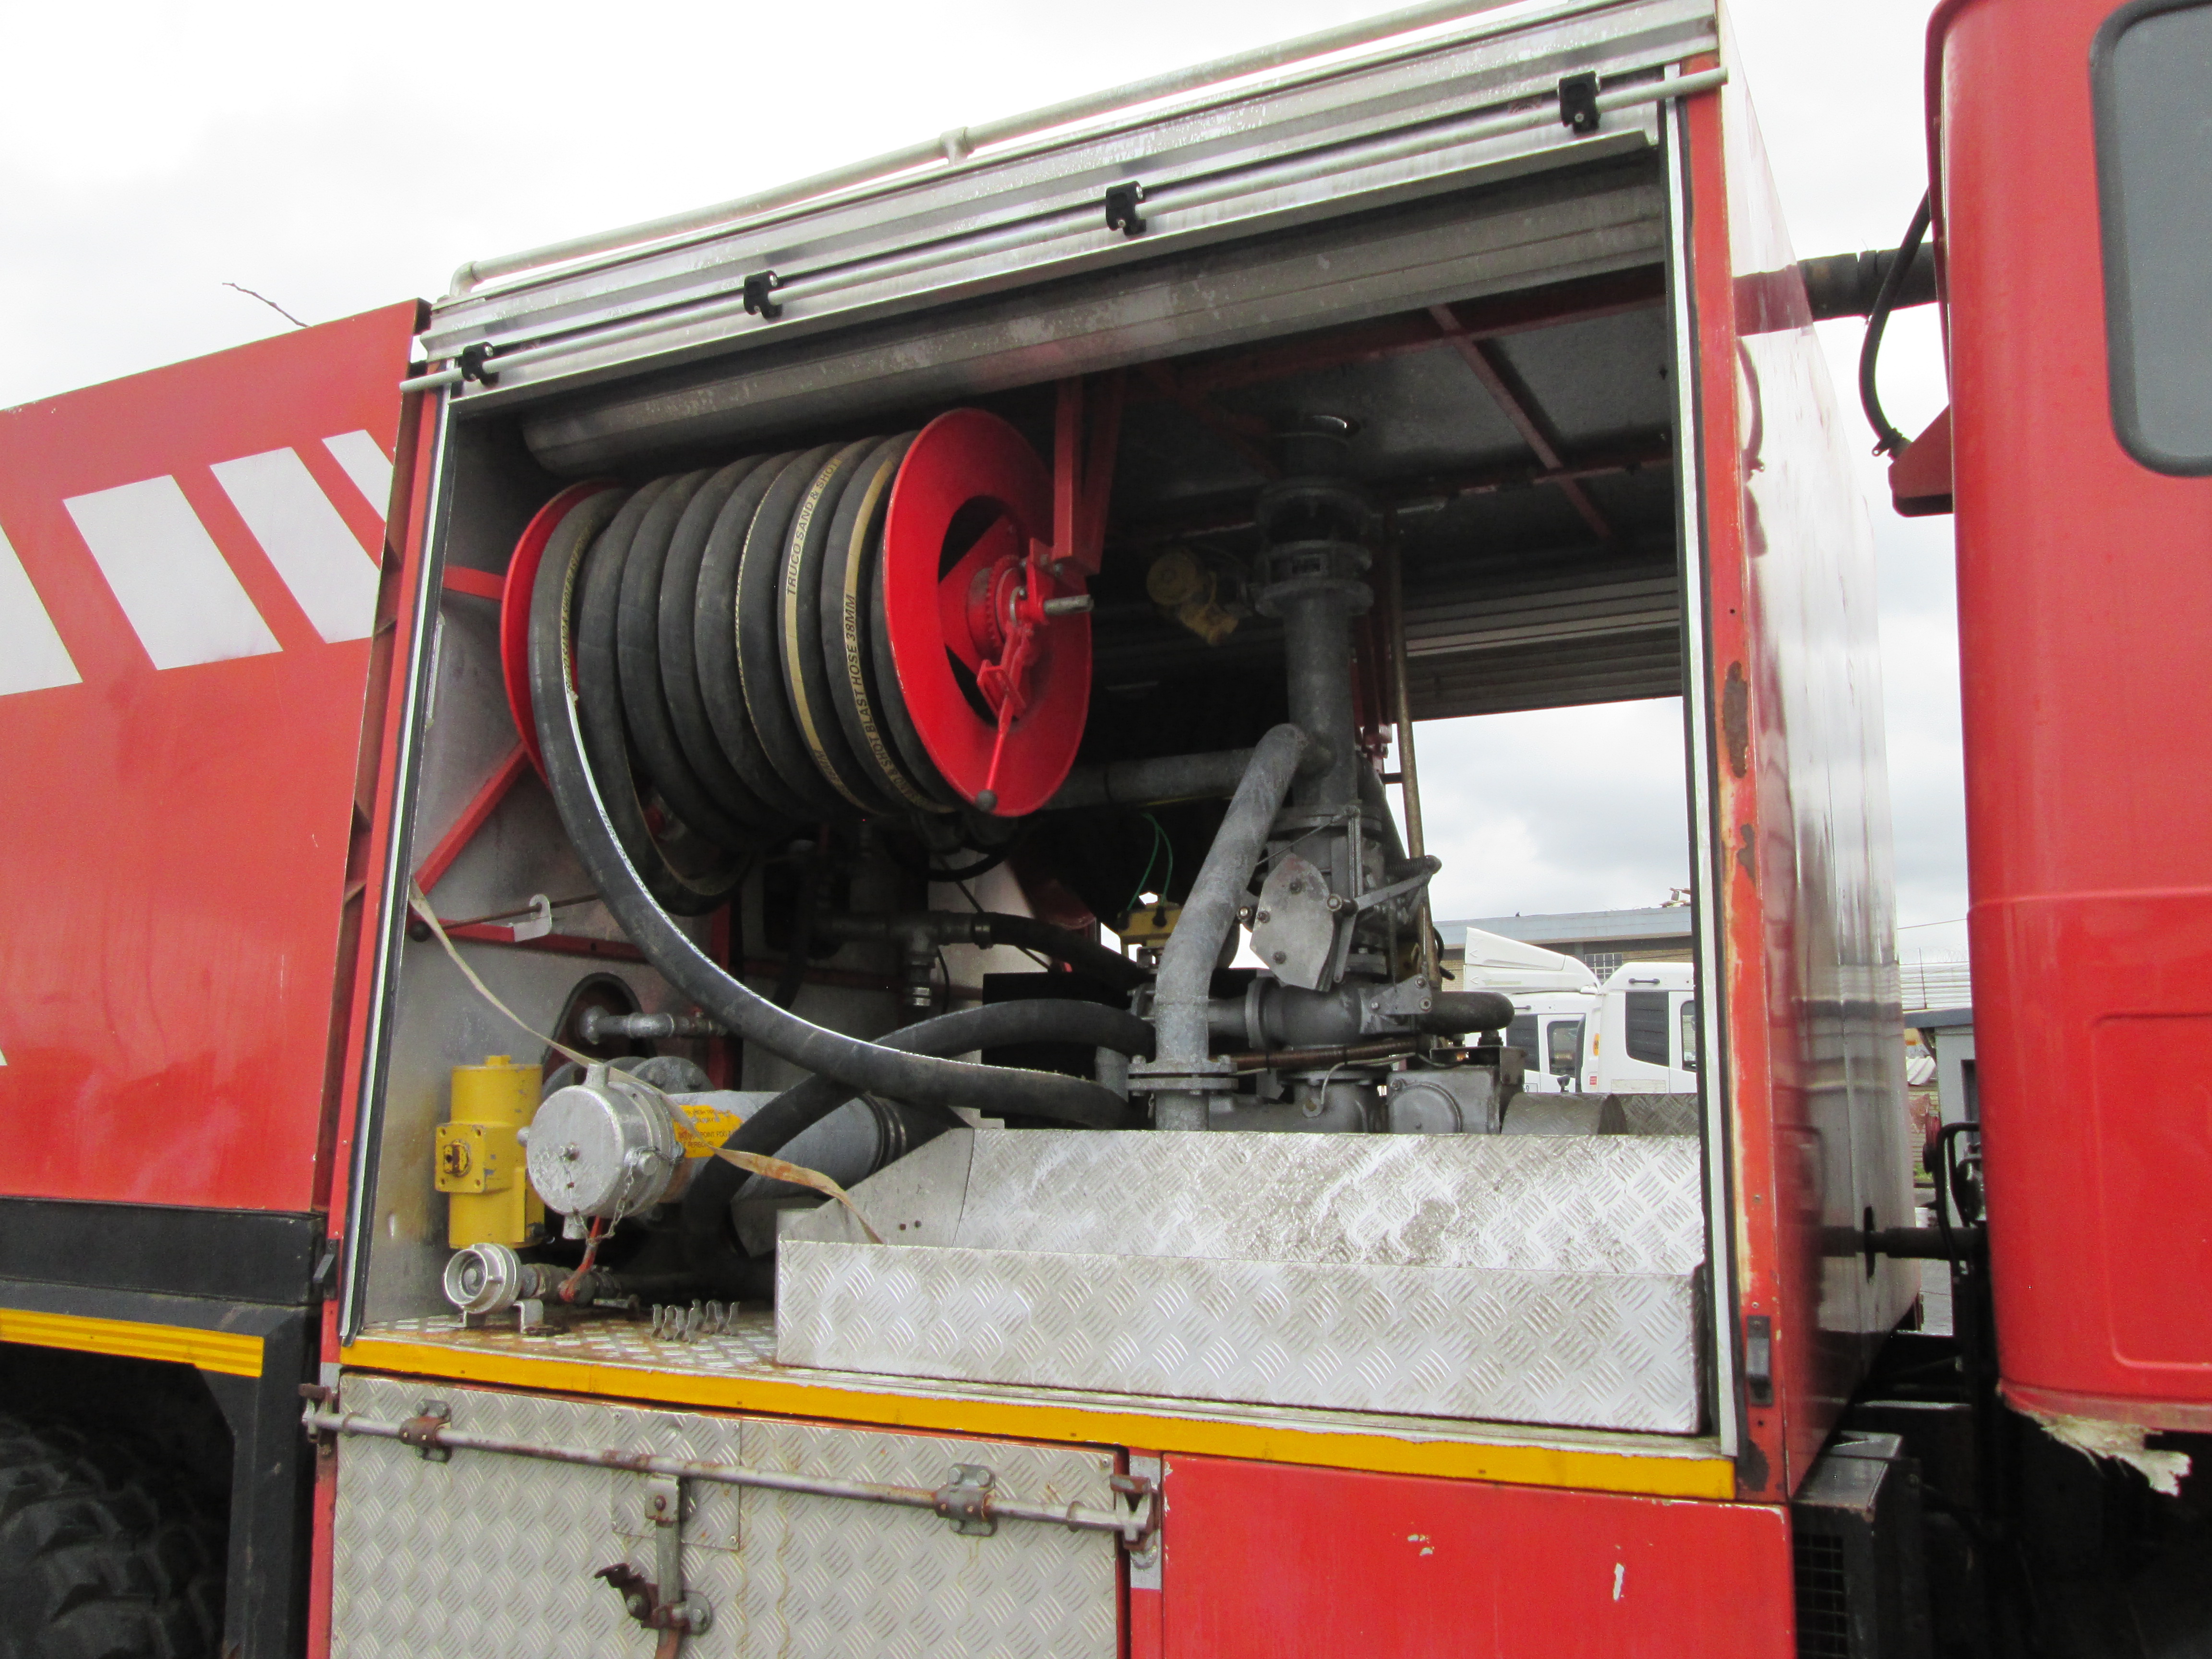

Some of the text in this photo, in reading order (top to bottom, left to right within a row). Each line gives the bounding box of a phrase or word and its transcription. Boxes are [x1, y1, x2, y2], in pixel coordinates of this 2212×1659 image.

[787, 461, 839, 595] TRUCO SAND & SHOT
[845, 595, 856, 641] 38MM
[847, 644, 862, 685] HOSE
[855, 688, 877, 733] BLAST
[869, 736, 891, 767] SHOT
[889, 768, 899, 777] &
